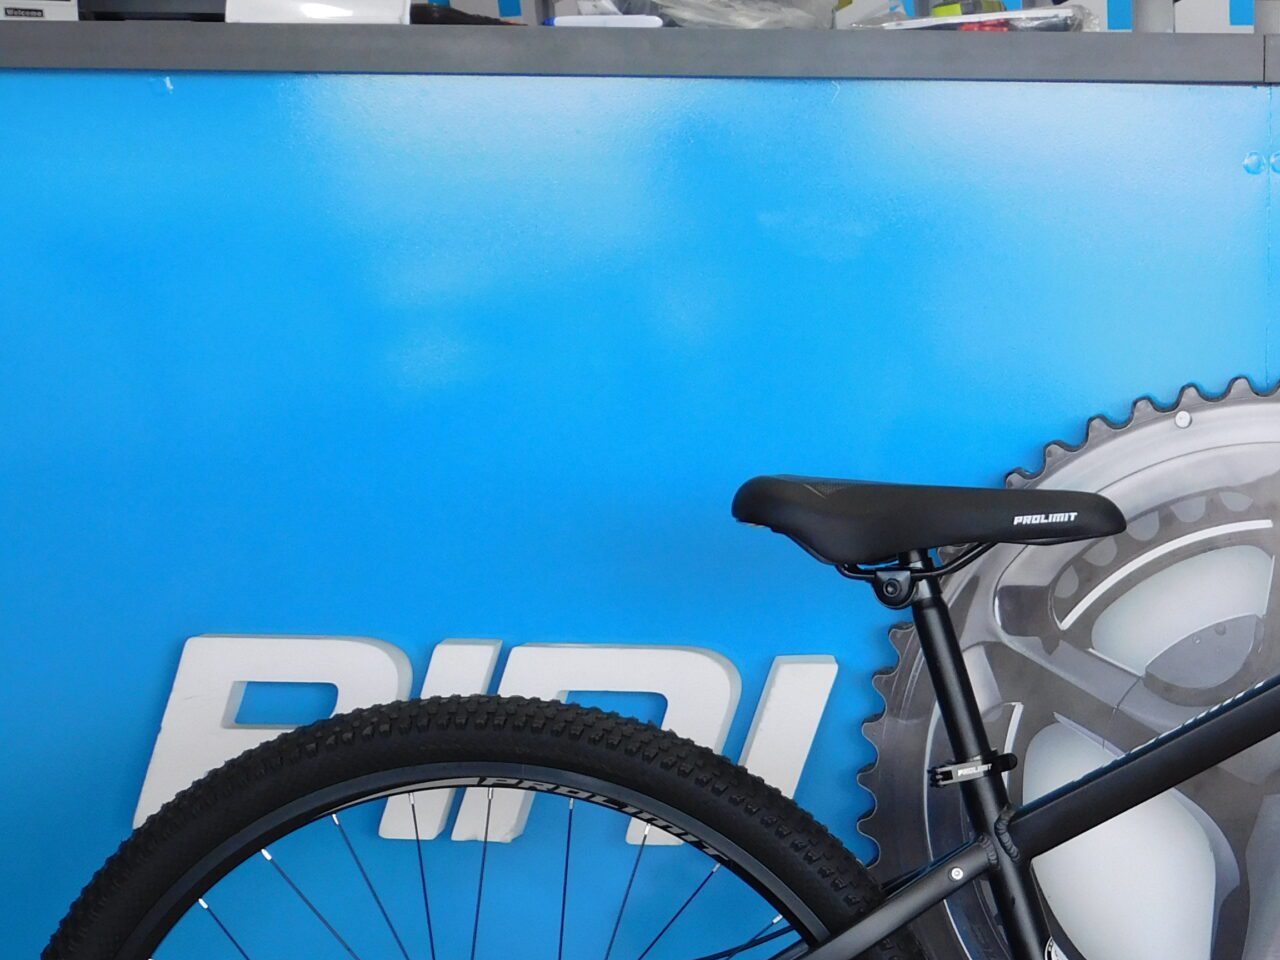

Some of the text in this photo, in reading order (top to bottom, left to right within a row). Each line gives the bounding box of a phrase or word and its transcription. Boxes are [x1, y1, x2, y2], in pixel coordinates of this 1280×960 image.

[1012, 510, 1079, 526] PROLIMIT
[132, 635, 839, 845] PINI
[480, 776, 731, 865] PROLIMIT
